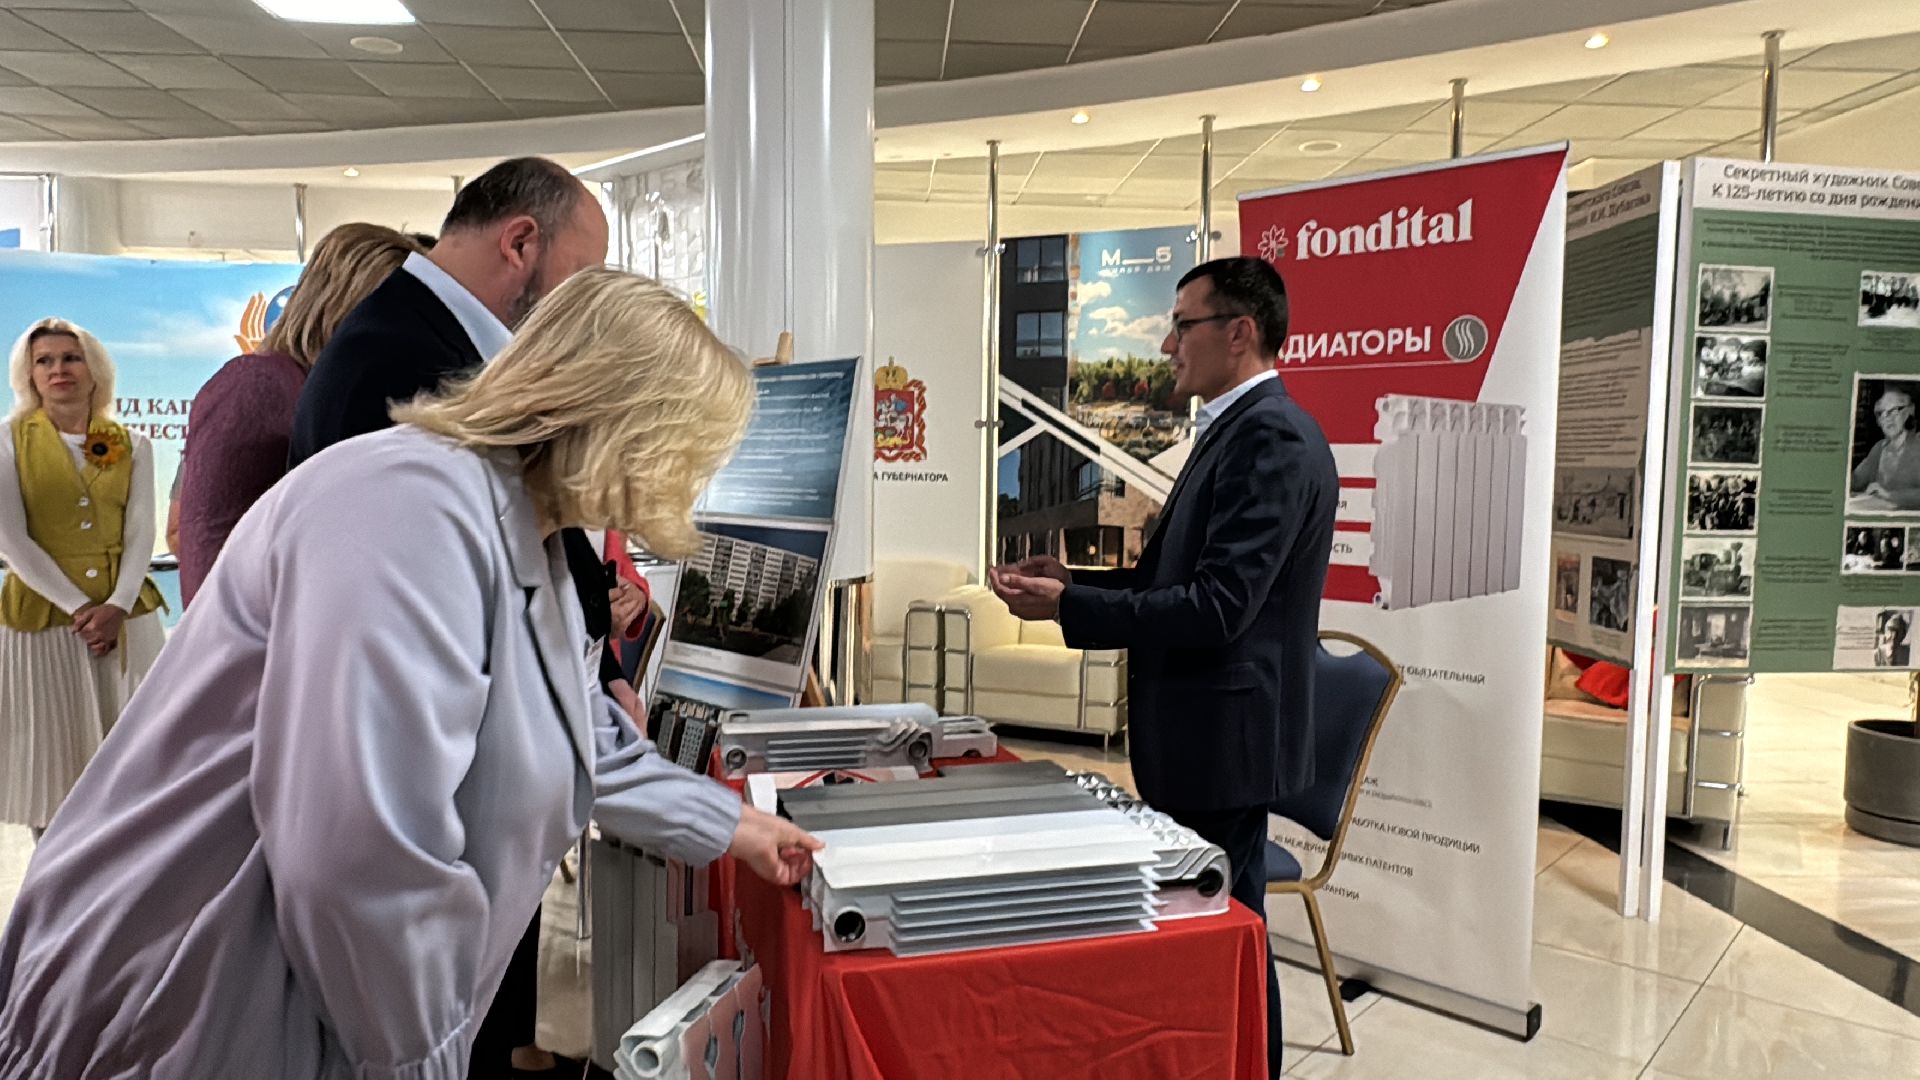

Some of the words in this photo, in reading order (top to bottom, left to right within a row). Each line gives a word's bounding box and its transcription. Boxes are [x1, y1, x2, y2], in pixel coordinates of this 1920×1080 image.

[1723, 164, 1809, 183] Секретный
[1812, 171, 1889, 188] художник
[1712, 183, 1723, 197] К
[1726, 184, 1807, 203] 125-летию
[1810, 192, 1826, 204] со
[1828, 193, 1858, 206] дня
[1296, 198, 1473, 260] fondital
[1278, 326, 1432, 364] ДИАТОРЫ
[881, 472, 949, 482] ГУБЕРНАТОРА
[1331, 543, 1353, 554] СТЬ
[1351, 816, 1386, 833] АБОТКА
[1387, 823, 1420, 840] НОВОЙ
[1422, 831, 1481, 854] ПРОДУКЦИИ
[1364, 858, 1414, 877] ПАТЕНТОВ
